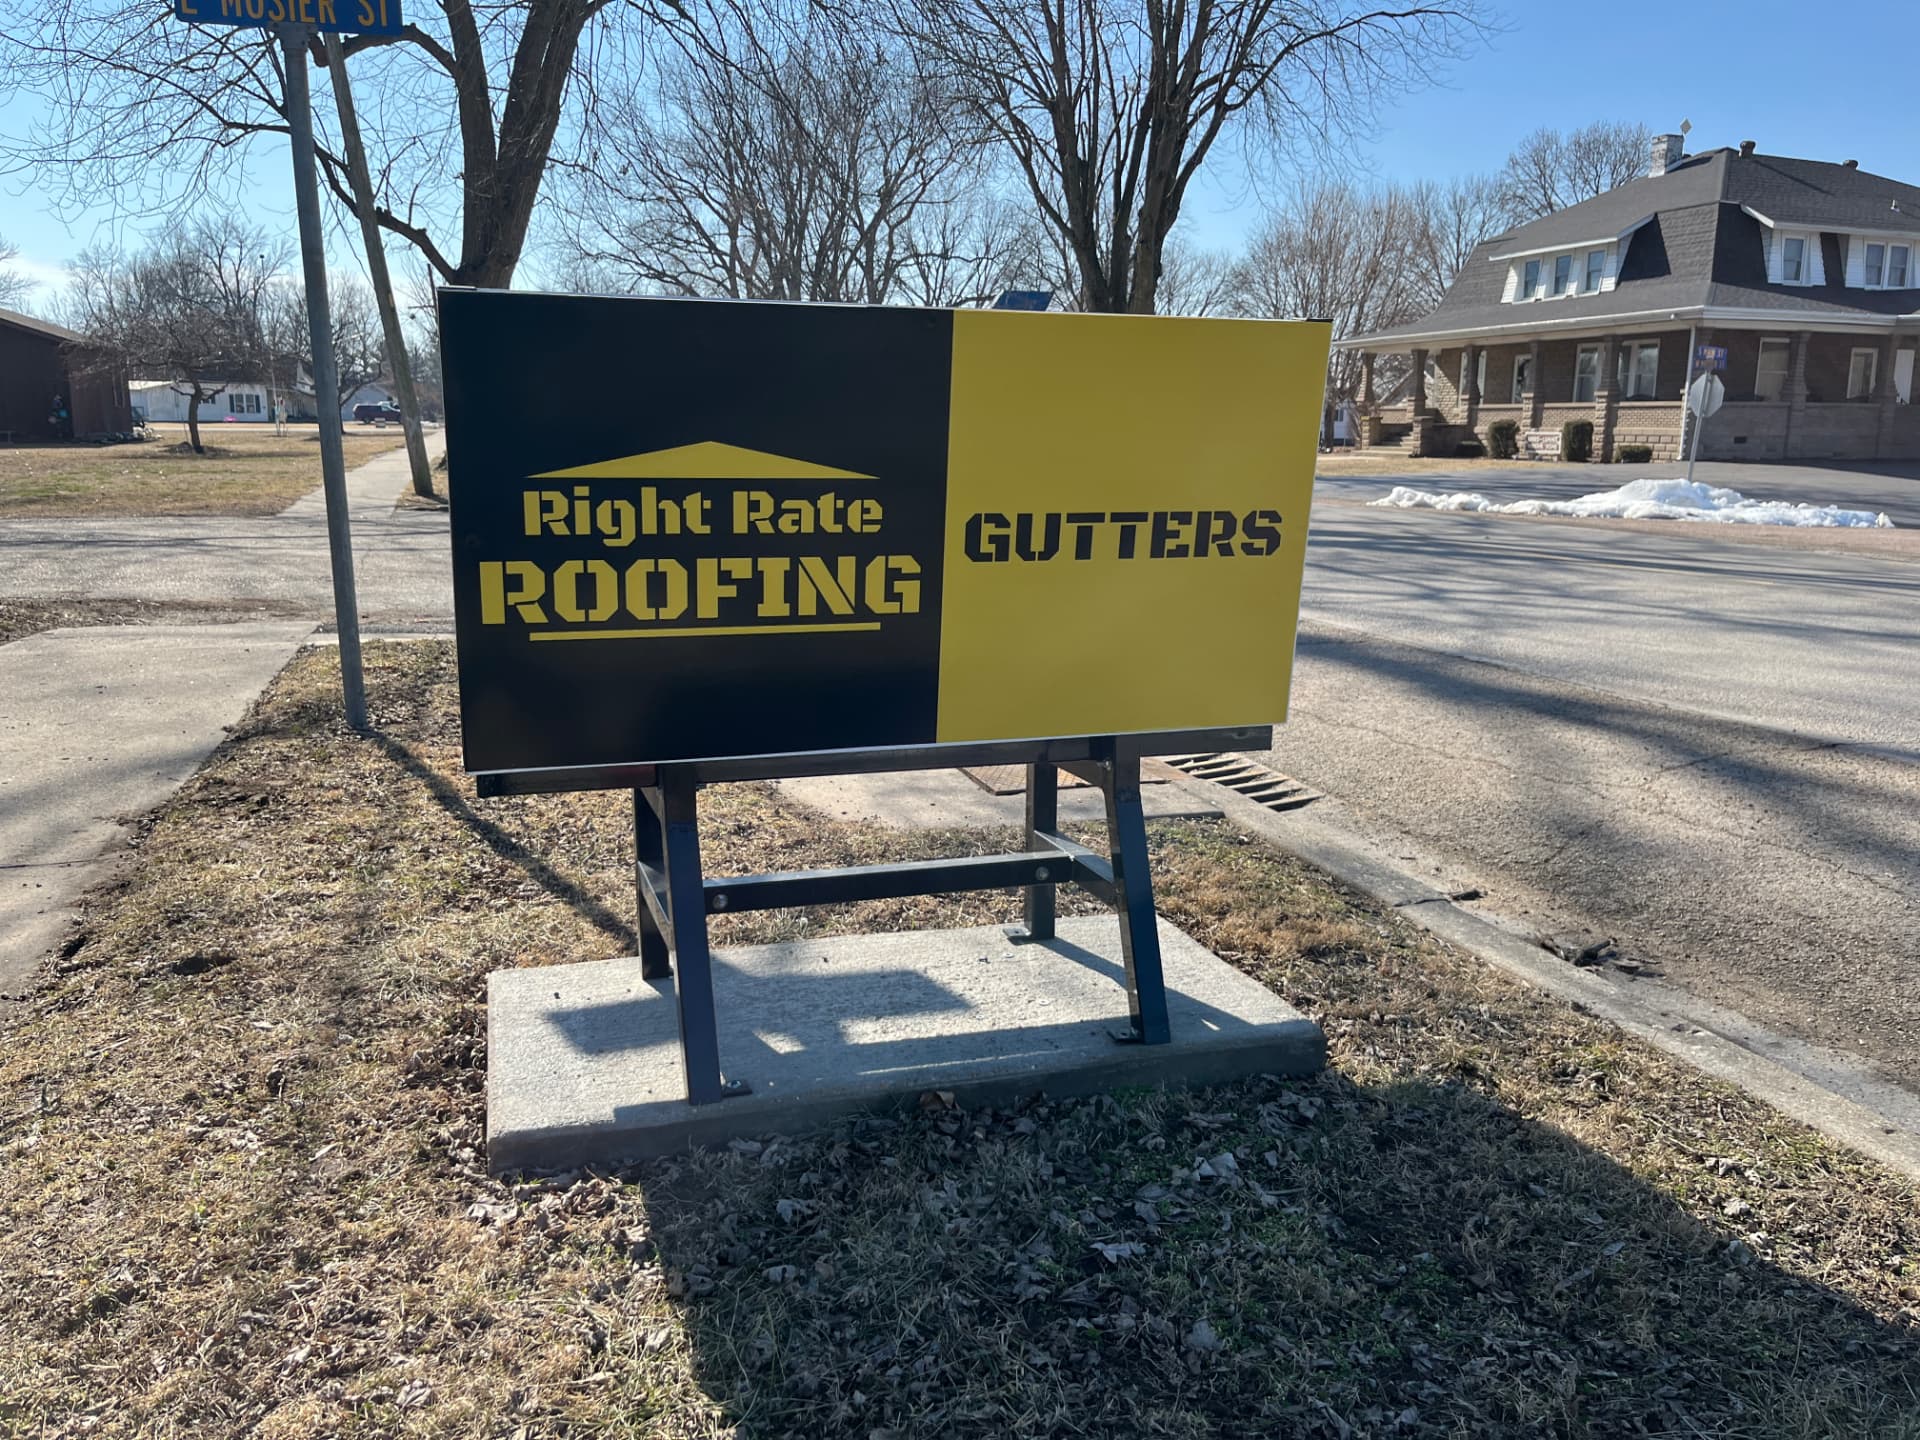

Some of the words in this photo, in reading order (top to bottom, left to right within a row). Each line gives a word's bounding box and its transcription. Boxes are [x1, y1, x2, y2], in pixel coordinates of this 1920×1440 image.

[523, 485, 712, 547] Right
[732, 490, 883, 534] Rate
[964, 510, 1283, 563] GUTTERS
[479, 555, 922, 625] ROOFING
